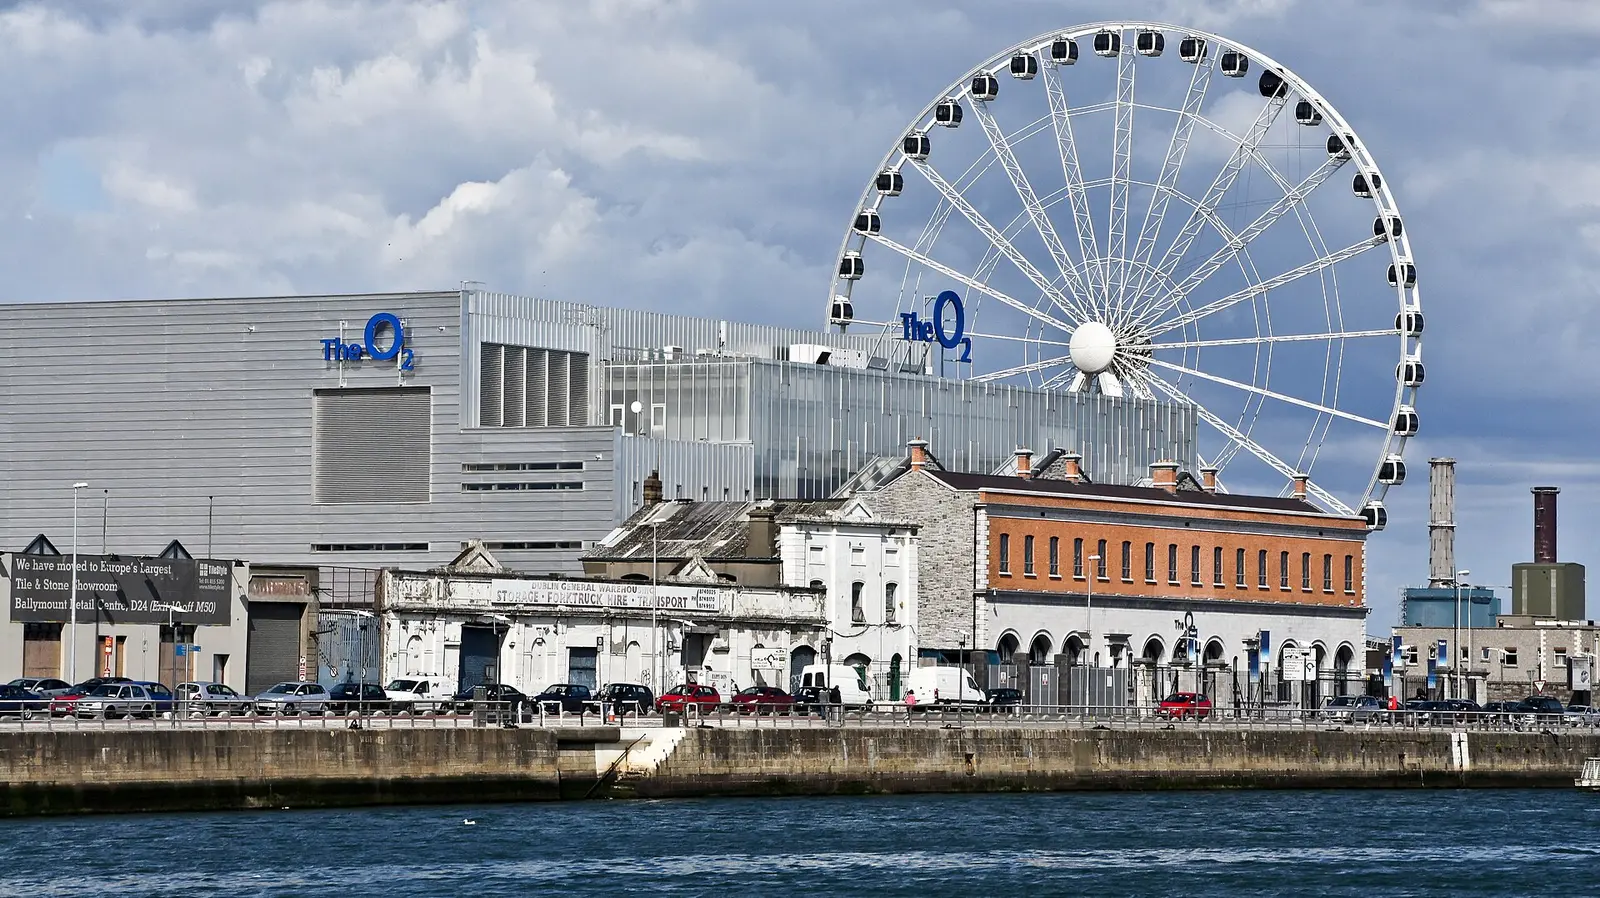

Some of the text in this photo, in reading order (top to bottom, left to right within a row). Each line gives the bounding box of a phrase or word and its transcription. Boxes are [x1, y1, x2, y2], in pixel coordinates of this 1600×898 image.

[900, 312, 933, 342] The
[320, 337, 362, 361] The
[15, 558, 31, 571] We
[32, 559, 55, 571] have
[89, 561, 99, 572] to
[100, 561, 138, 576] Europe's
[140, 562, 172, 577] Largest
[15, 578, 33, 591] Tile
[34, 578, 41, 591] &
[43, 579, 70, 591] Stone
[531, 581, 559, 591] DUBLIN
[560, 582, 596, 592] GENERAL
[15, 597, 68, 612] Ballymount
[97, 599, 129, 612] Centre,
[131, 600, 148, 612] D24
[195, 602, 216, 614] M50)
[496, 590, 688, 608] STORAGE FORKTRUCK HIRE TRANSPORT
